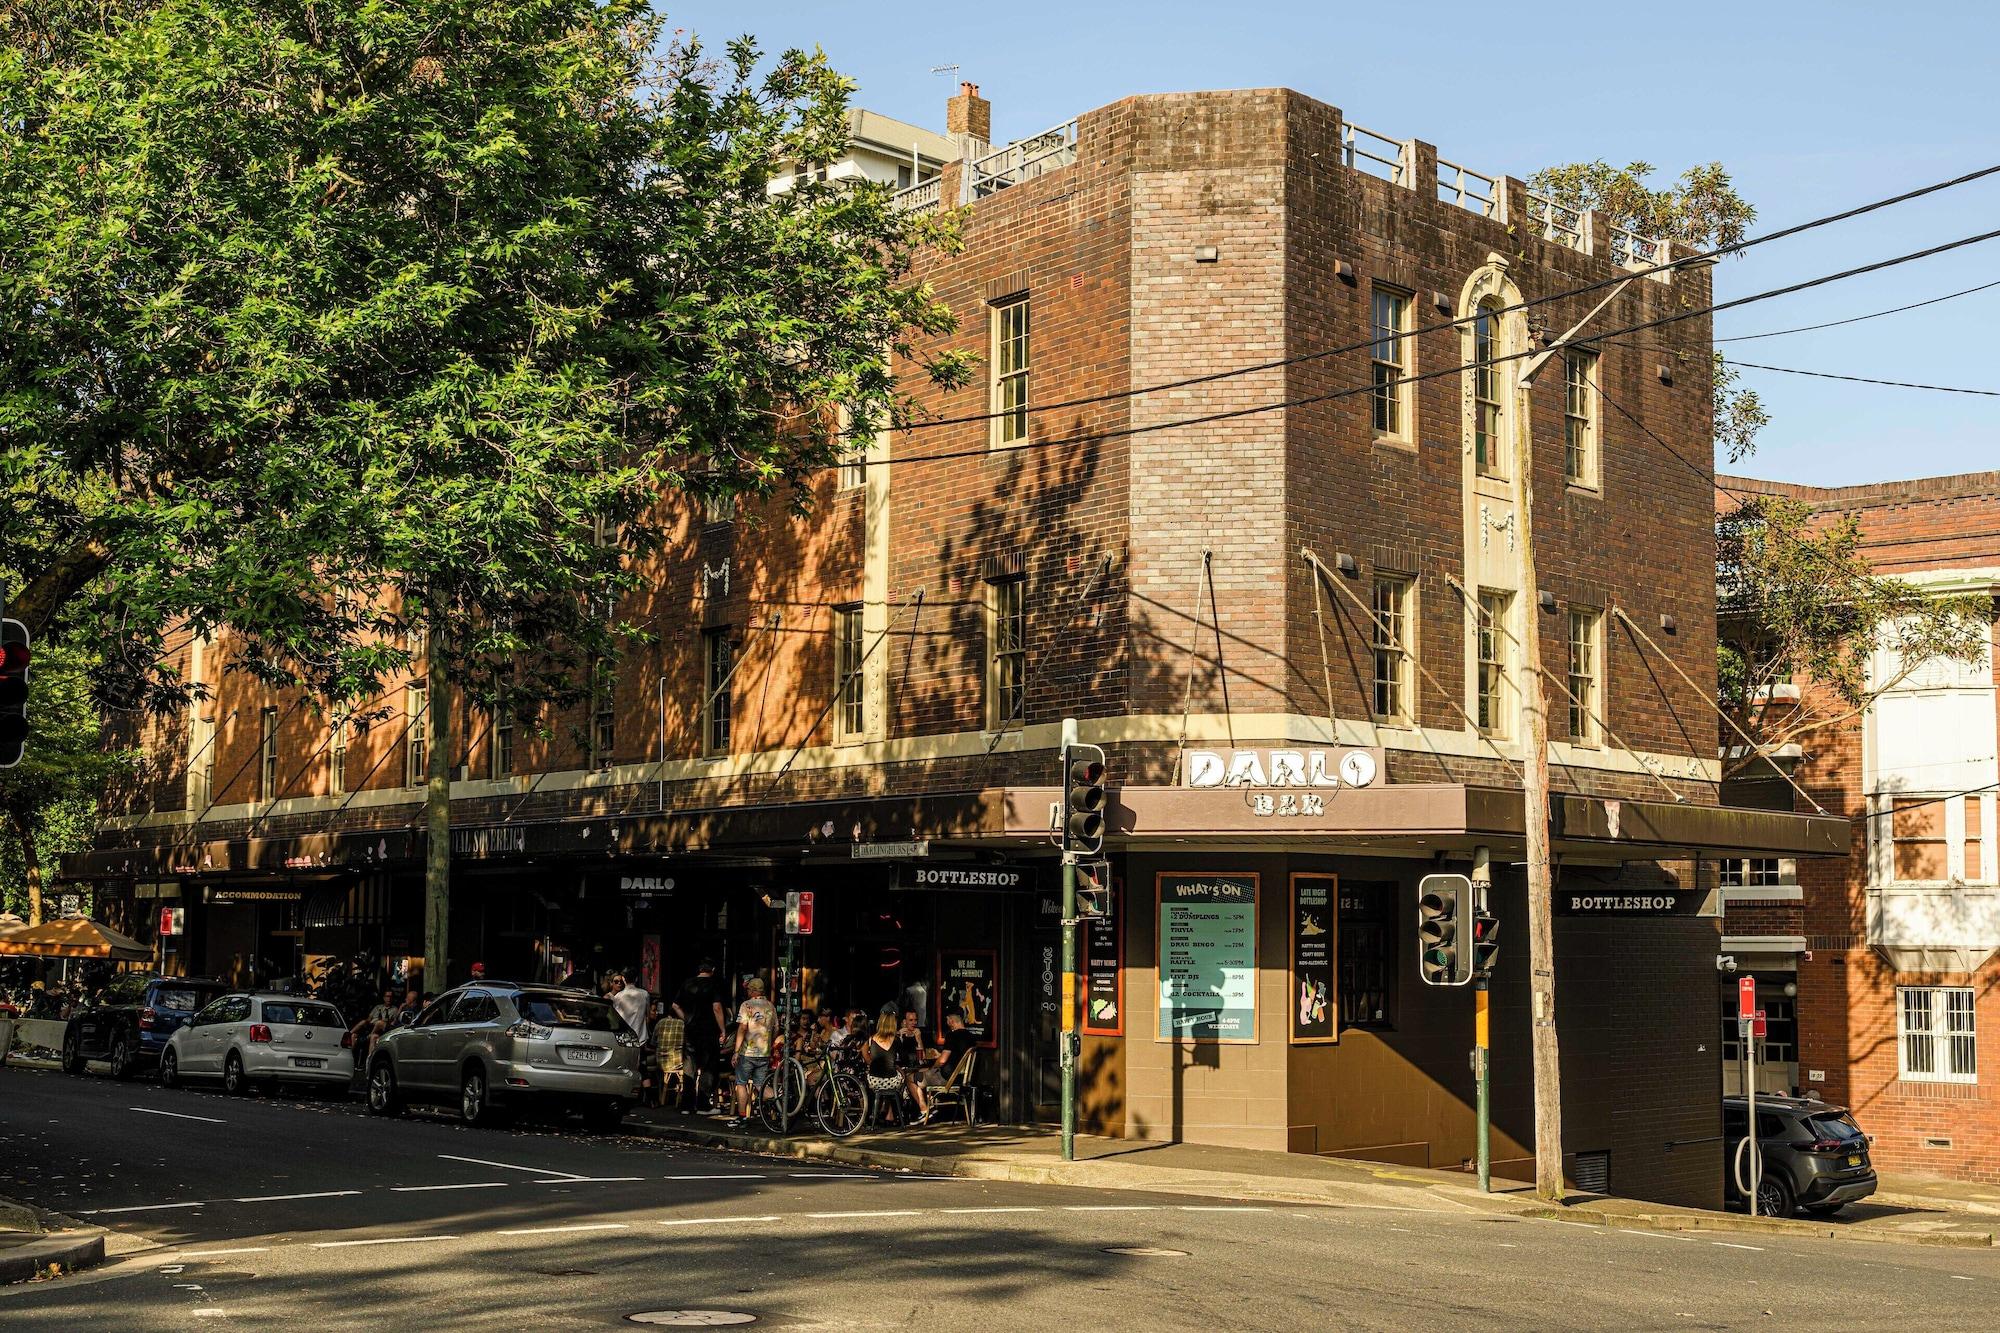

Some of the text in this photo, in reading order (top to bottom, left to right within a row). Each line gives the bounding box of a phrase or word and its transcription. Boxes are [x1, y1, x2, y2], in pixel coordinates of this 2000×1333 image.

[1189, 750, 1377, 788] DARLO
[1253, 794, 1325, 817] BAR
[620, 876, 675, 890] DARLO
[916, 869, 1020, 886] BOTTLESHOP
[215, 891, 302, 900] ACCOMMODATION
[1176, 883, 1241, 897] WHAT'S ON
[1300, 888, 1312, 897] LATE
[1571, 896, 1676, 910] BOTTLESHOP
